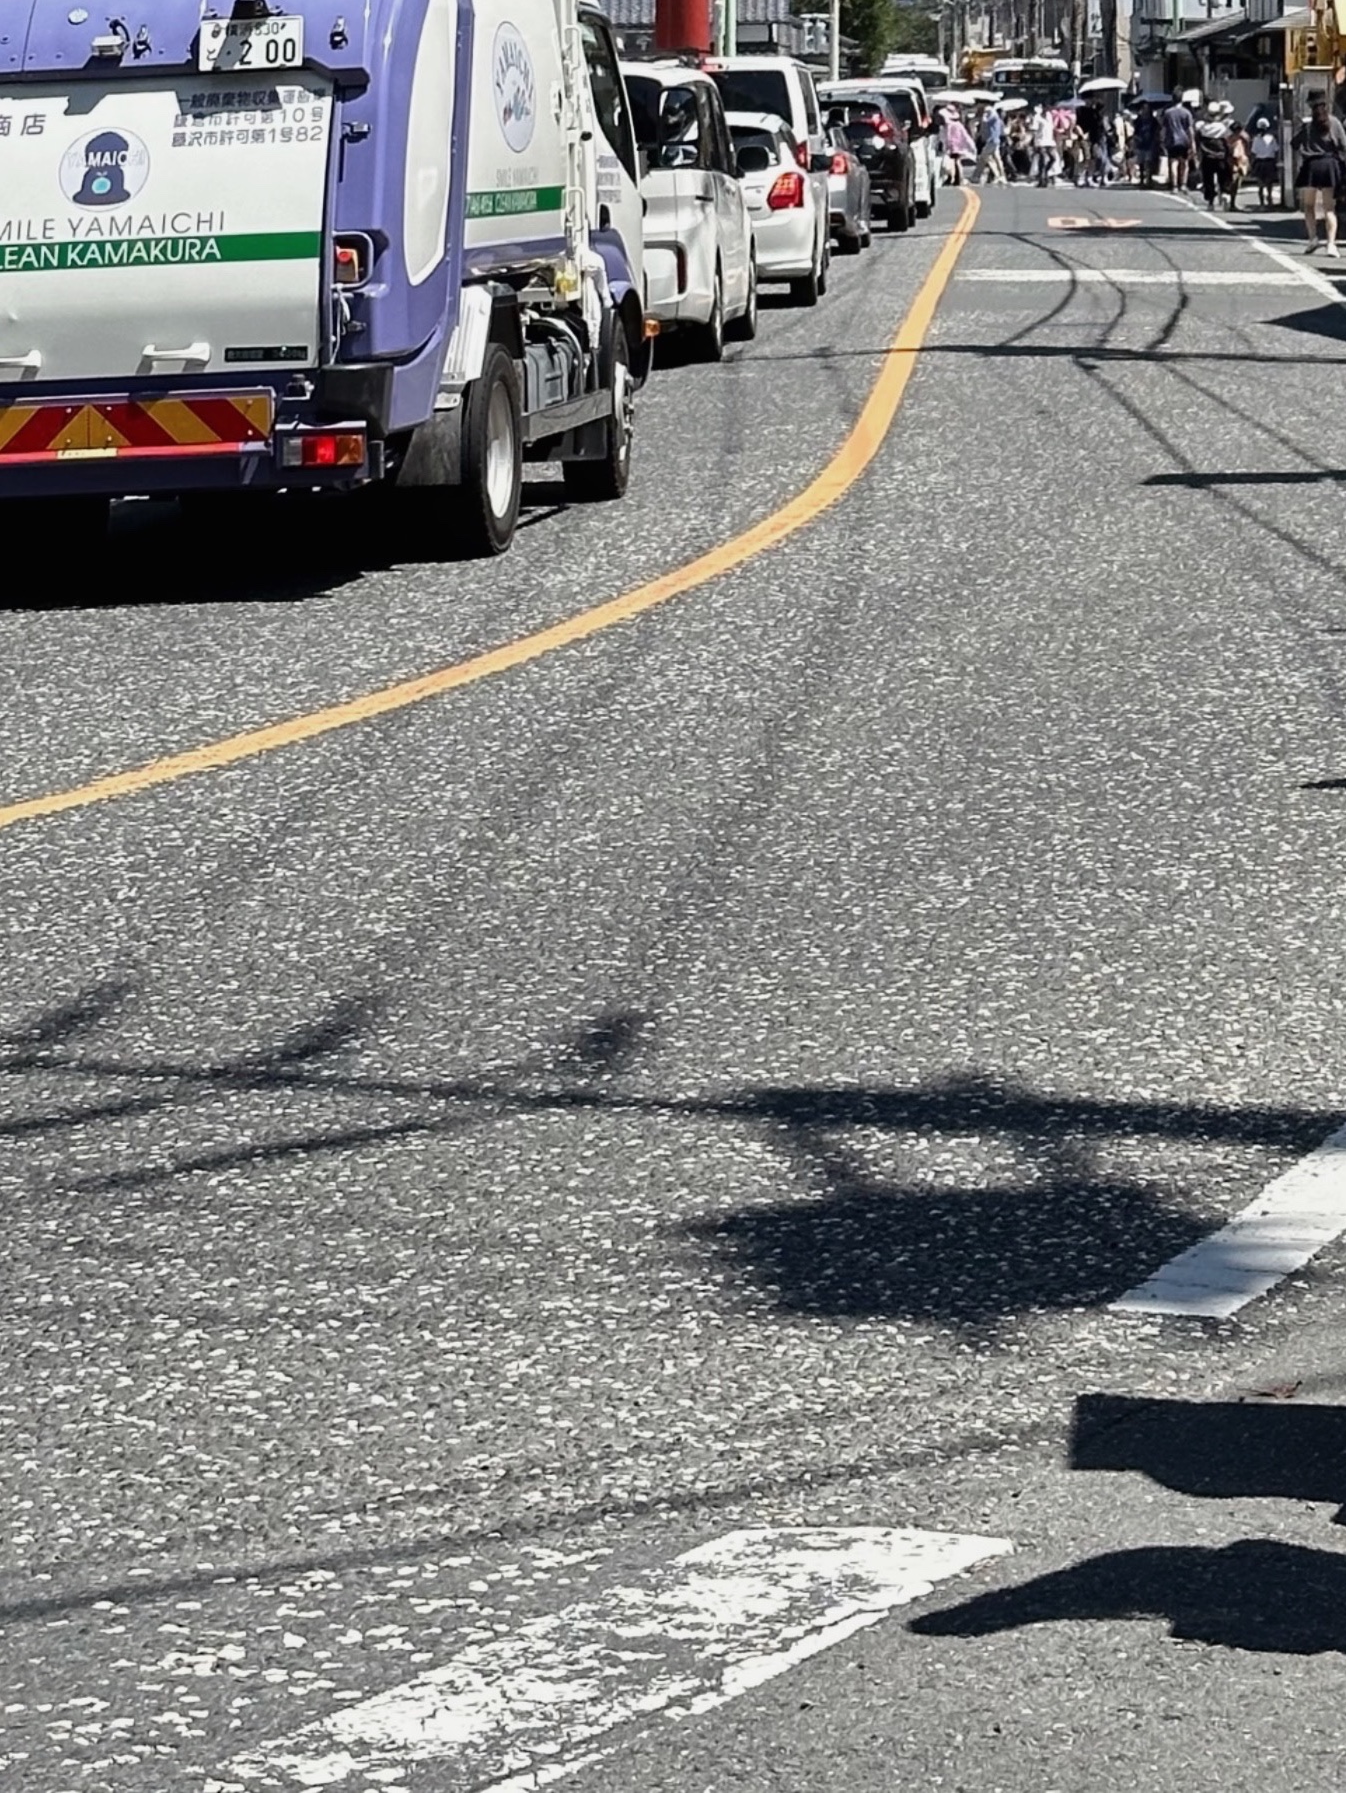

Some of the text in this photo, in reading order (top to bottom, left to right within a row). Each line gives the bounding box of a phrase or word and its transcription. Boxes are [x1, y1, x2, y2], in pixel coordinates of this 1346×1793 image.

[68, 211, 225, 237] YAMAICHI
[0, 237, 222, 269] EAN KAMAKURA
